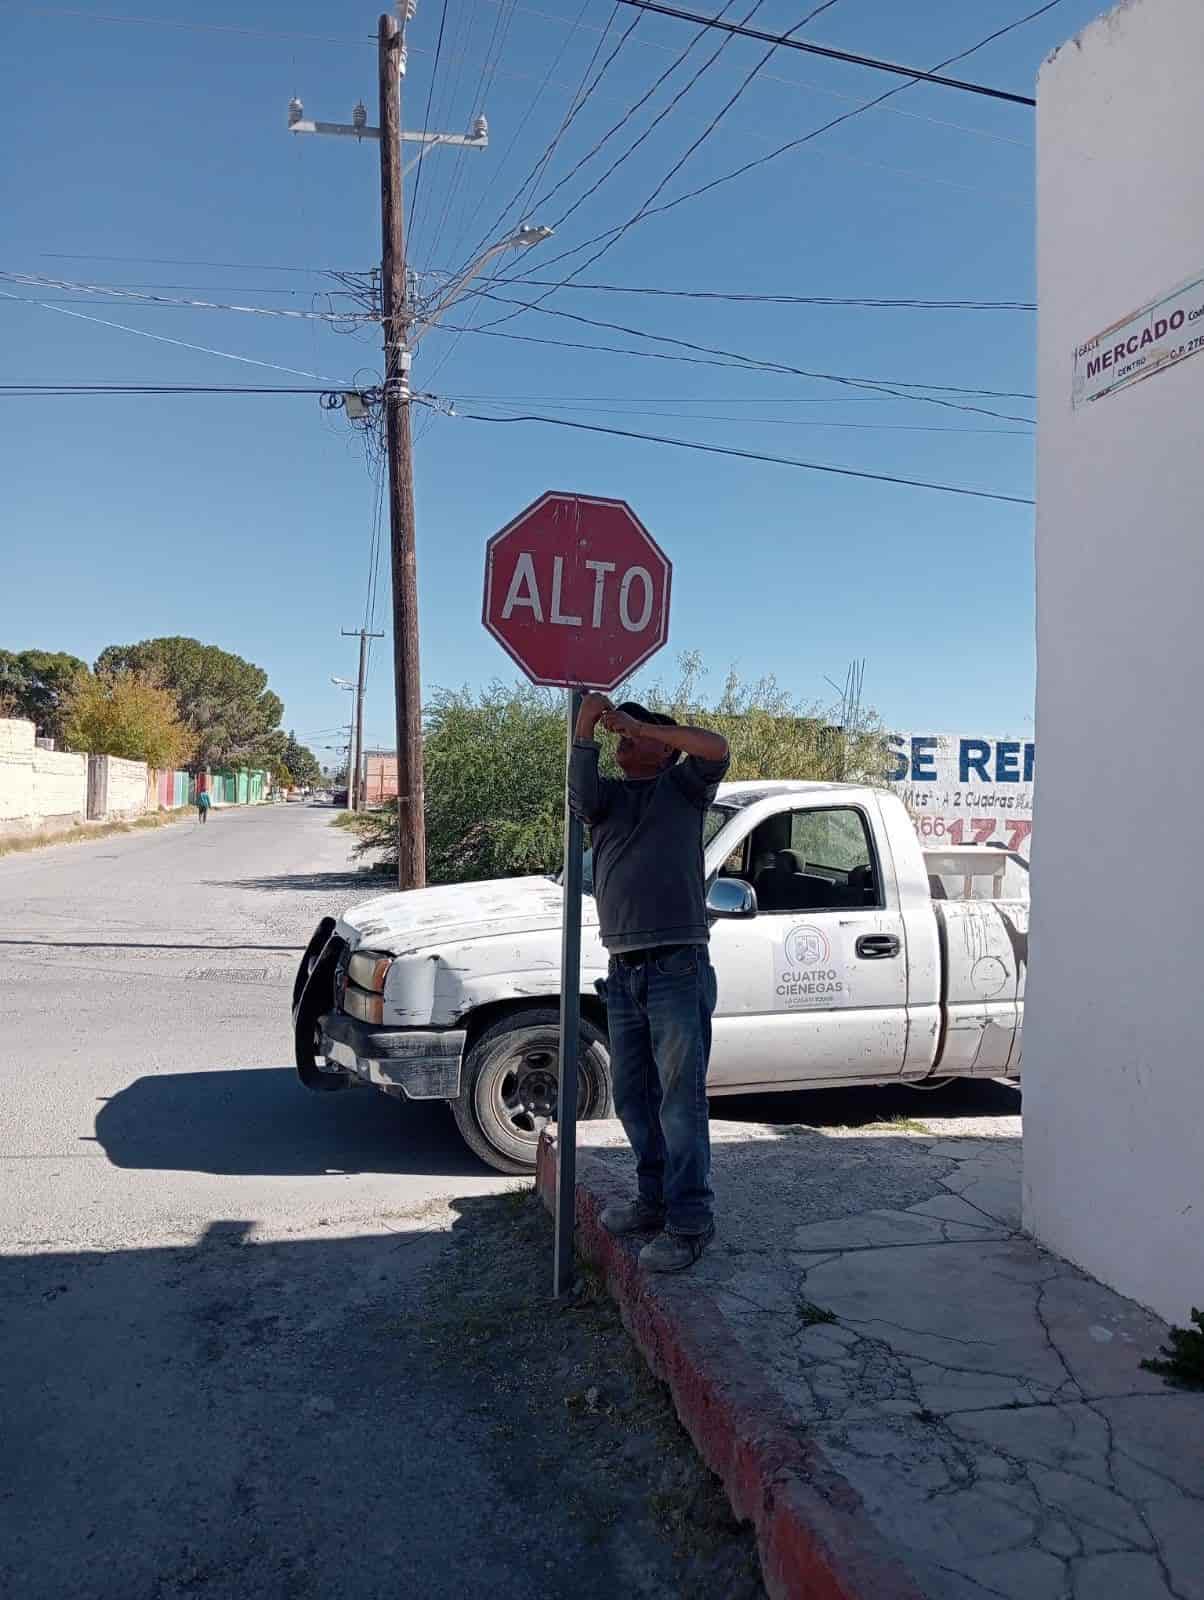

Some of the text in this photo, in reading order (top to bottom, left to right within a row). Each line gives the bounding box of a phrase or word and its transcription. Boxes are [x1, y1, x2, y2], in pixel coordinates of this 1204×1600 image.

[1087, 309, 1185, 378] MERCADO
[1118, 357, 1146, 377] CENTRO
[501, 552, 654, 632] ALTO
[882, 734, 938, 781] SE
[953, 791, 962, 806] 2
[966, 791, 1015, 810] Cuadras
[782, 969, 837, 983] CUATRO
